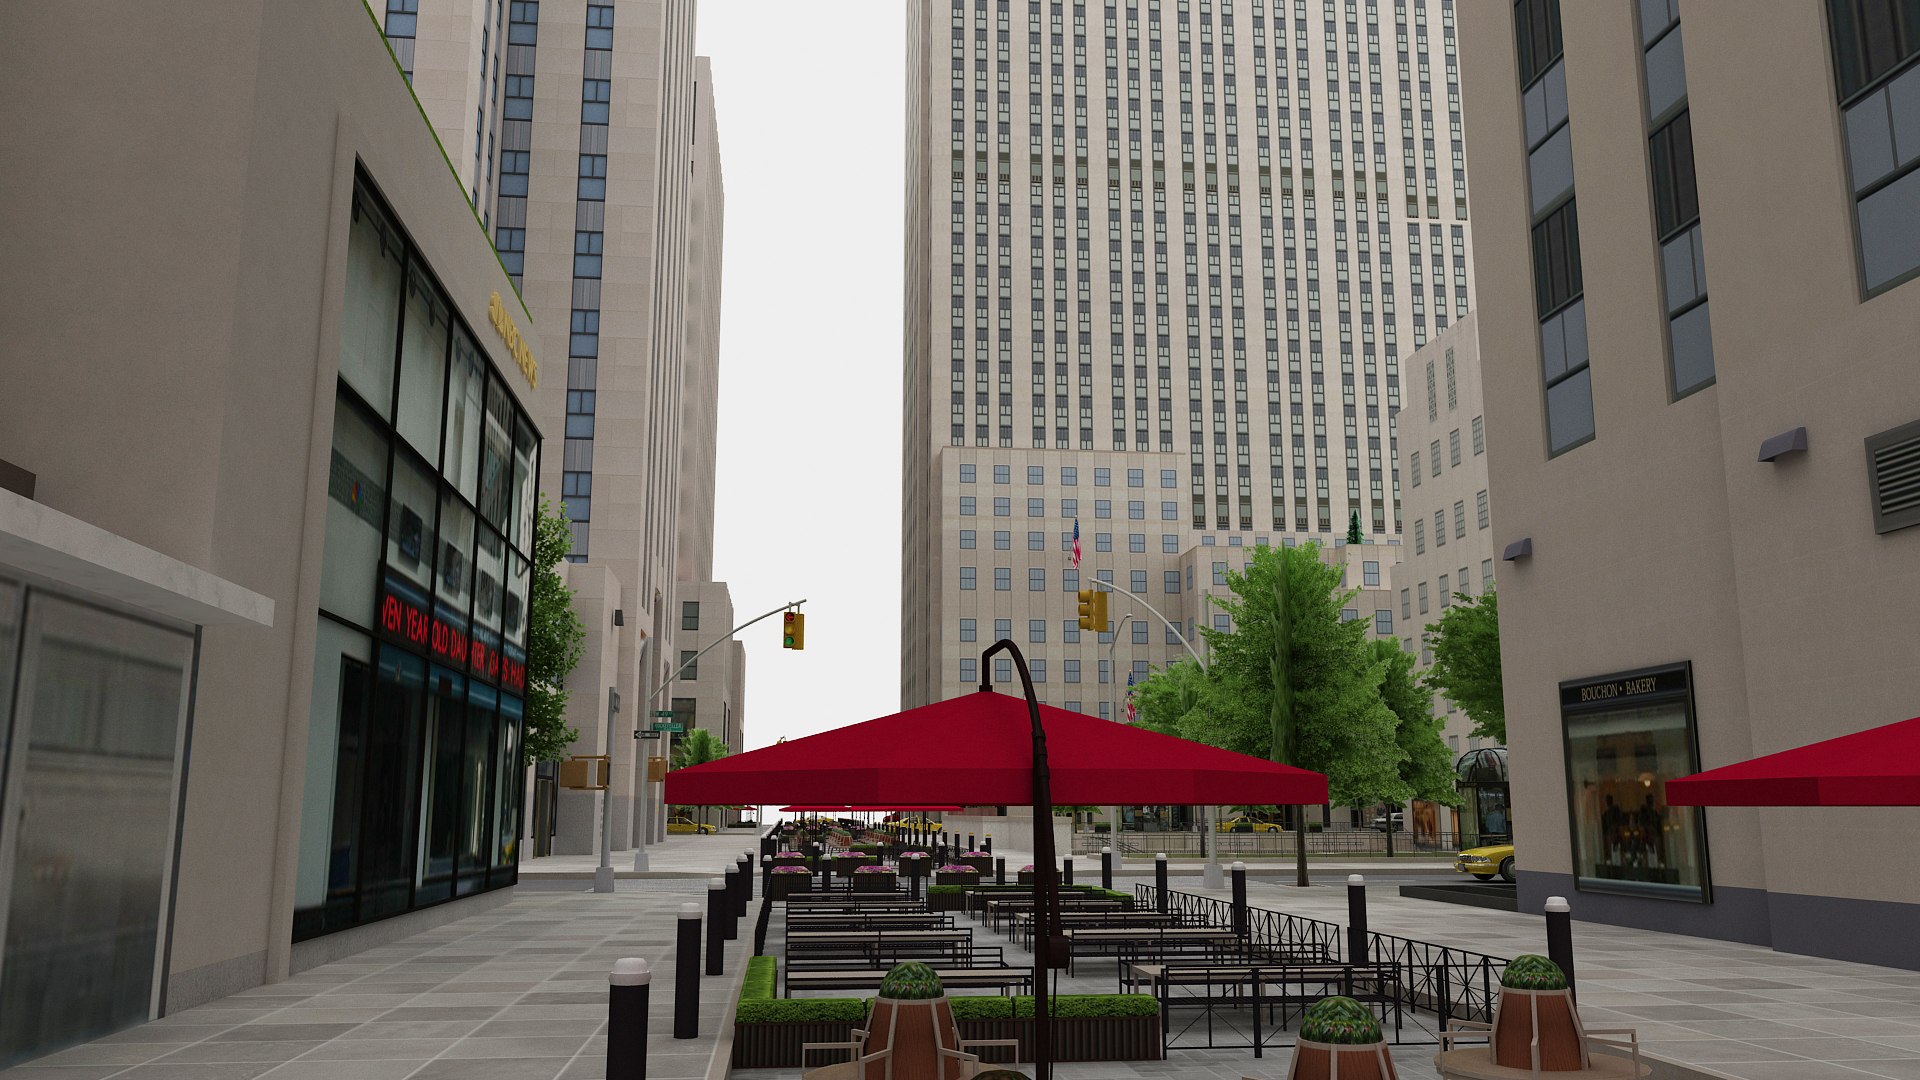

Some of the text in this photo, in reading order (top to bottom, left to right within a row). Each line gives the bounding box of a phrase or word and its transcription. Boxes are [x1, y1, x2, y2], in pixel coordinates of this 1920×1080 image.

[405, 604, 429, 645] YEAR
[431, 618, 449, 656] OLD
[1581, 677, 1656, 701] BOUCHON BAKERY
